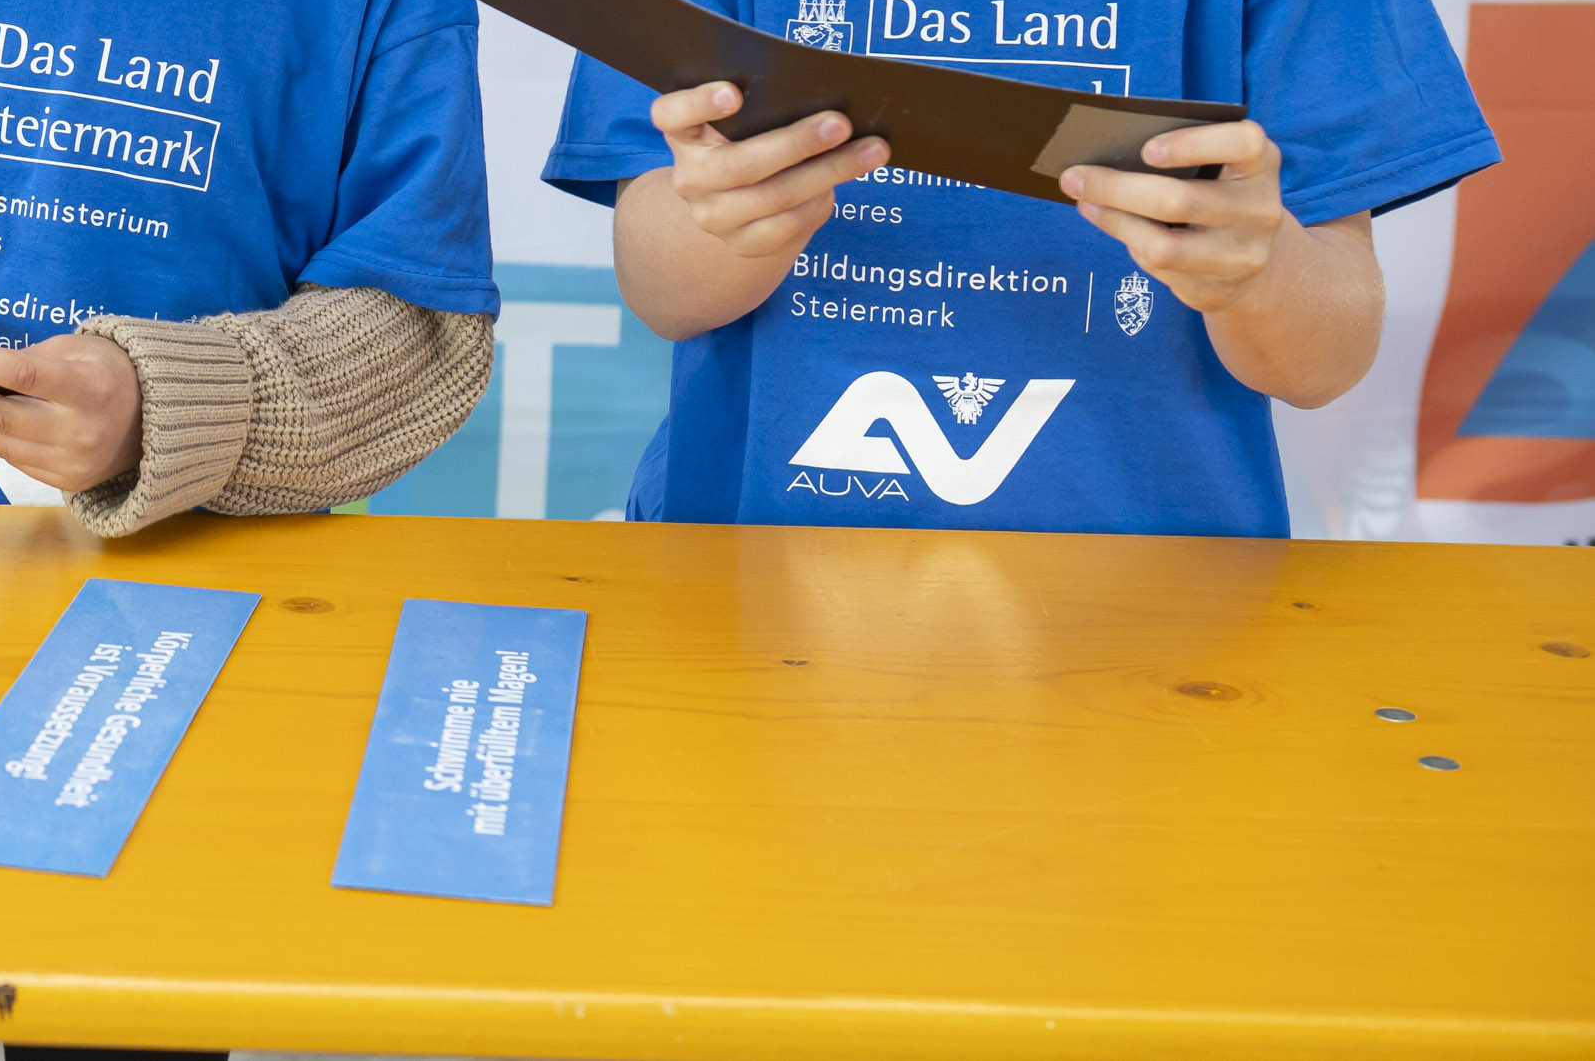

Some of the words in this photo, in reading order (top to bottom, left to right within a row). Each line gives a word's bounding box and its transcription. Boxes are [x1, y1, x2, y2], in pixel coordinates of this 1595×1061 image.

[990, 0, 1118, 50] Land
[98, 38, 220, 104] Land
[792, 253, 1068, 295] Bildungsdirektion
[790, 291, 955, 329] Steiermark
[786, 471, 910, 501] AUVA
[89, 643, 132, 663] ist
[114, 630, 192, 712] Körperliche
[487, 649, 537, 702] Magen!
[440, 679, 480, 703] nie
[4, 664, 118, 780] Voraussetzung!
[422, 705, 475, 792] Schwimme
[54, 713, 141, 808] Gesundheit
[469, 706, 521, 799] überfülltem
